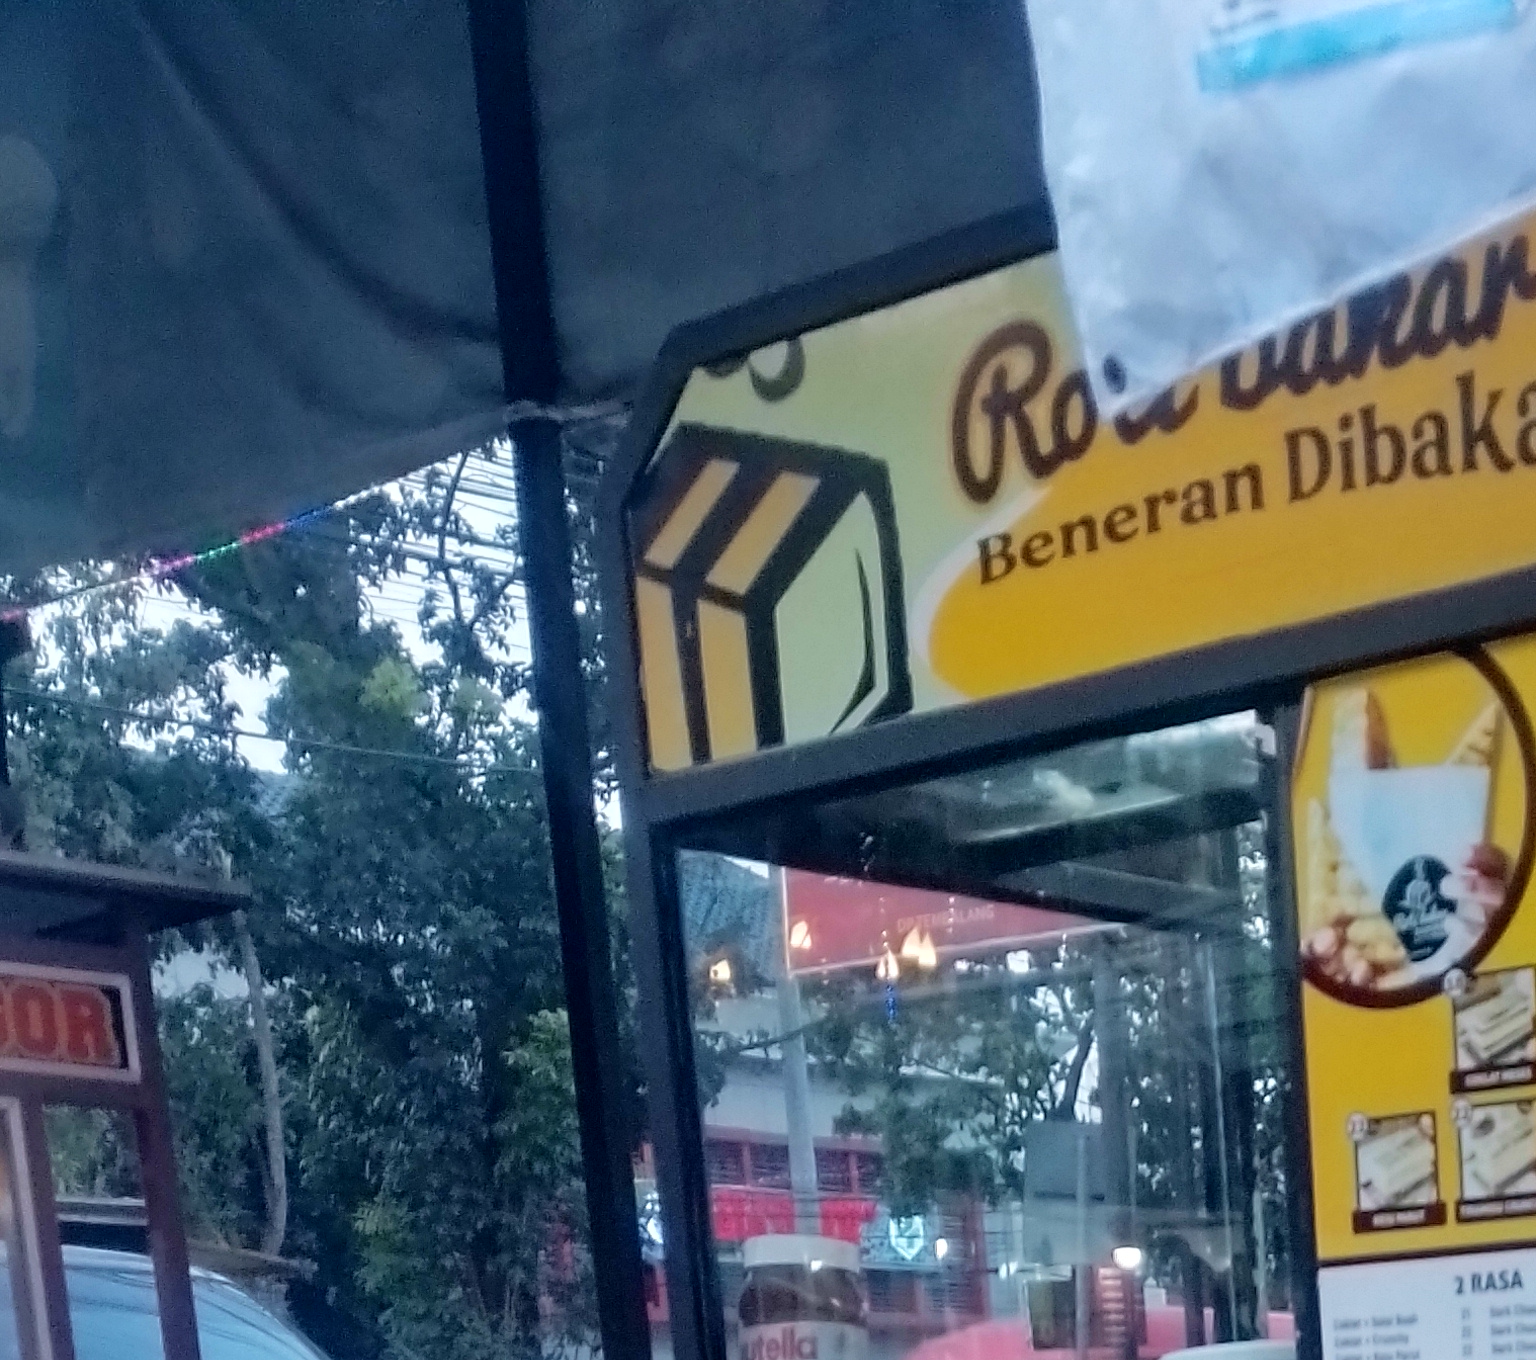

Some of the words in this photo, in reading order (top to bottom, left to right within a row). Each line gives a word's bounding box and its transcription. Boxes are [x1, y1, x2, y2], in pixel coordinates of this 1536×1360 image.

[952, 318, 1200, 505] Ro
[977, 461, 1265, 586] Beneran
[1454, 1275, 1465, 1295] 2
[1471, 1269, 1524, 1293] RASA
